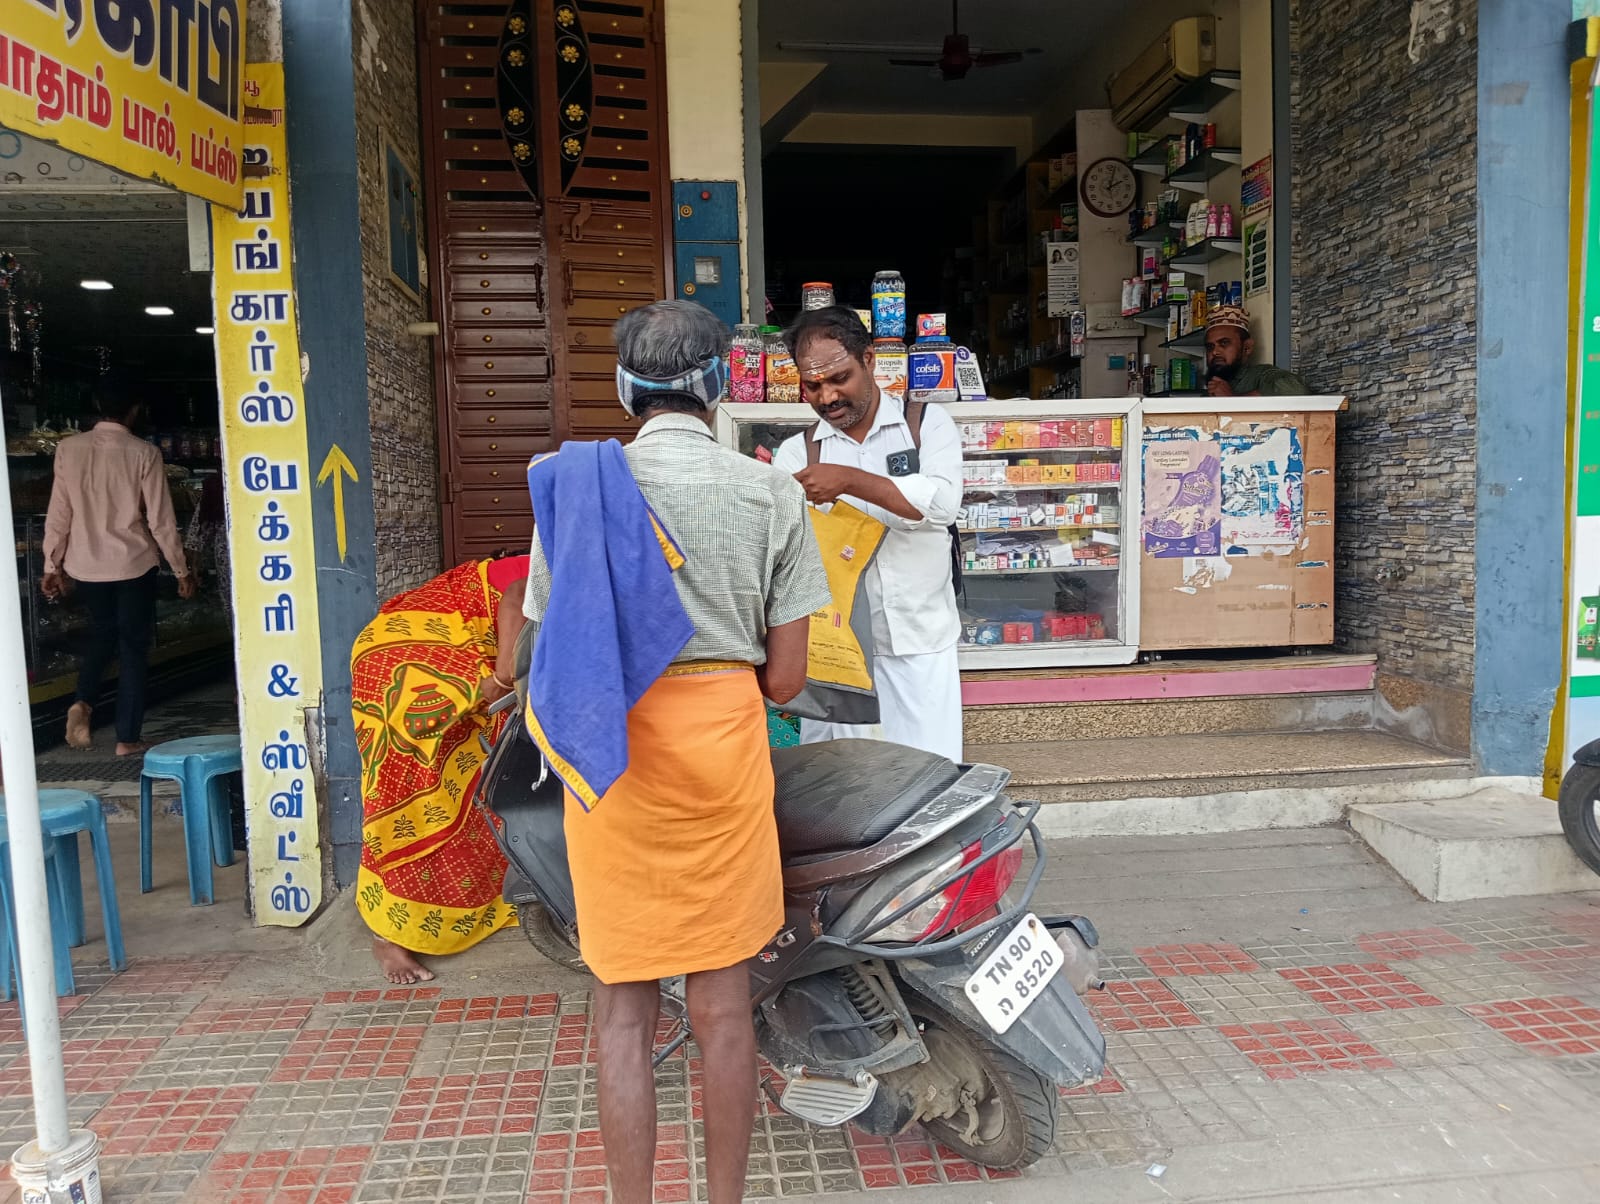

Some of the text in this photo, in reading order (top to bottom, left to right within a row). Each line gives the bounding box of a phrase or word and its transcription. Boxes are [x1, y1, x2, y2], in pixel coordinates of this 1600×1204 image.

[123, 101, 182, 167] பால்,
[191, 127, 238, 186] பப்ஸ்
[915, 363, 941, 374] cofsils
[243, 456, 298, 633] பேக்கரி
[267, 664, 299, 697] &
[261, 729, 310, 913] ஸ்வீட்ஸ்
[985, 935, 1032, 985] TN 90
[1015, 950, 1054, 998] 8520
